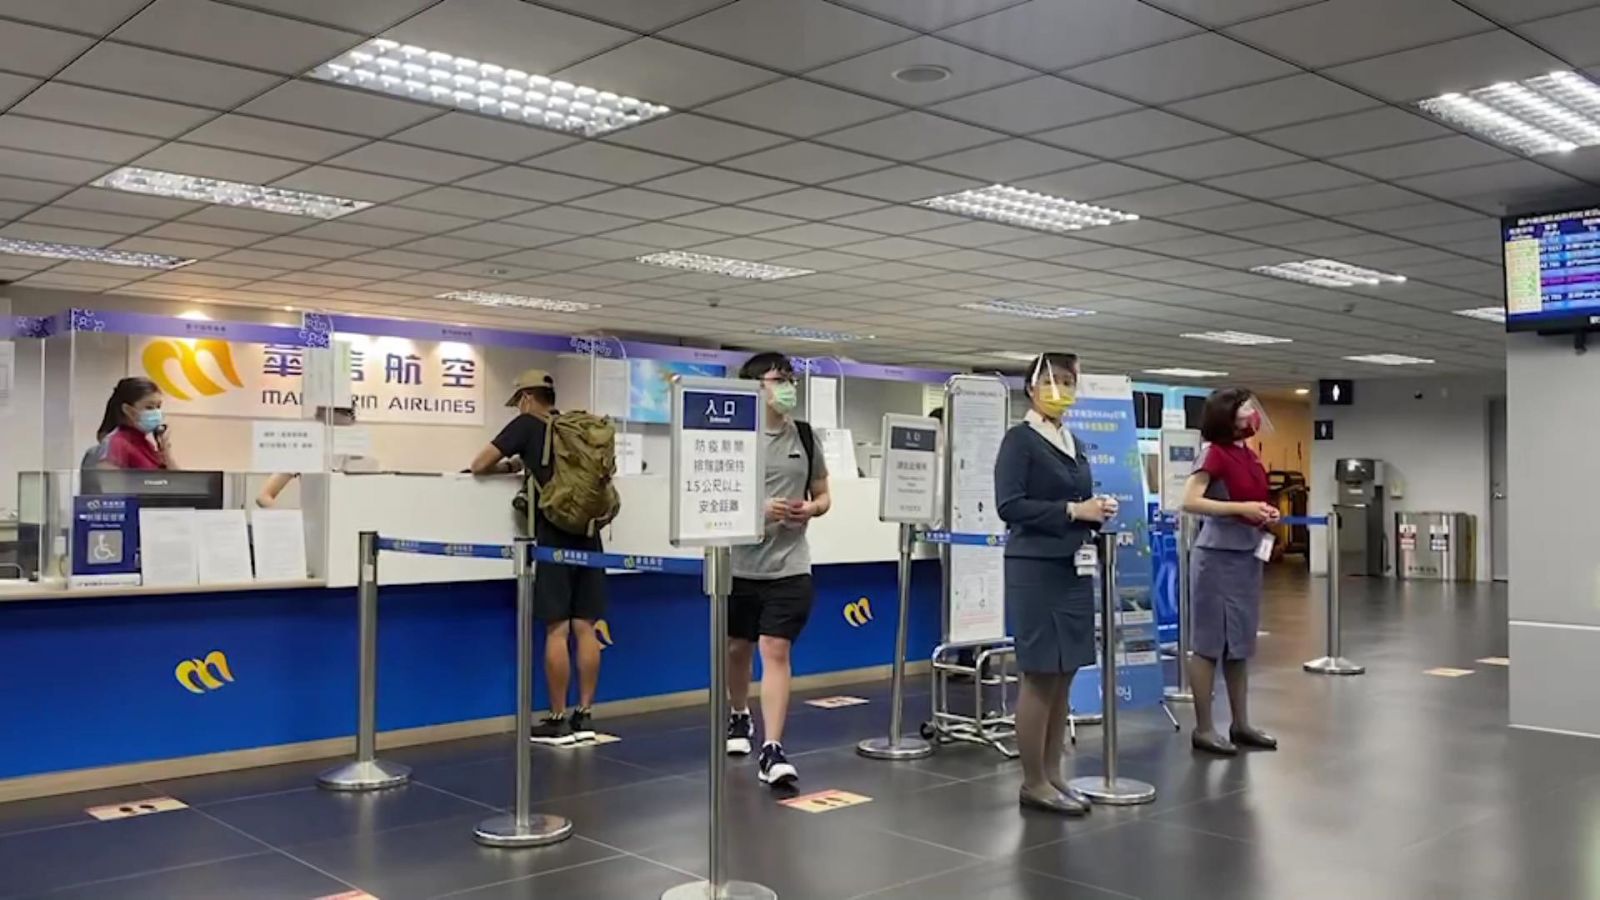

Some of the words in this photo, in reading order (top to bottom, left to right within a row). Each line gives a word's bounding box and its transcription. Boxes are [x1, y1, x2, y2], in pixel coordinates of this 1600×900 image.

[262, 390, 378, 410] MARIN
[388, 397, 475, 413] AIRLINES
[705, 399, 735, 416] 入口
[698, 500, 739, 514] 安全距離
